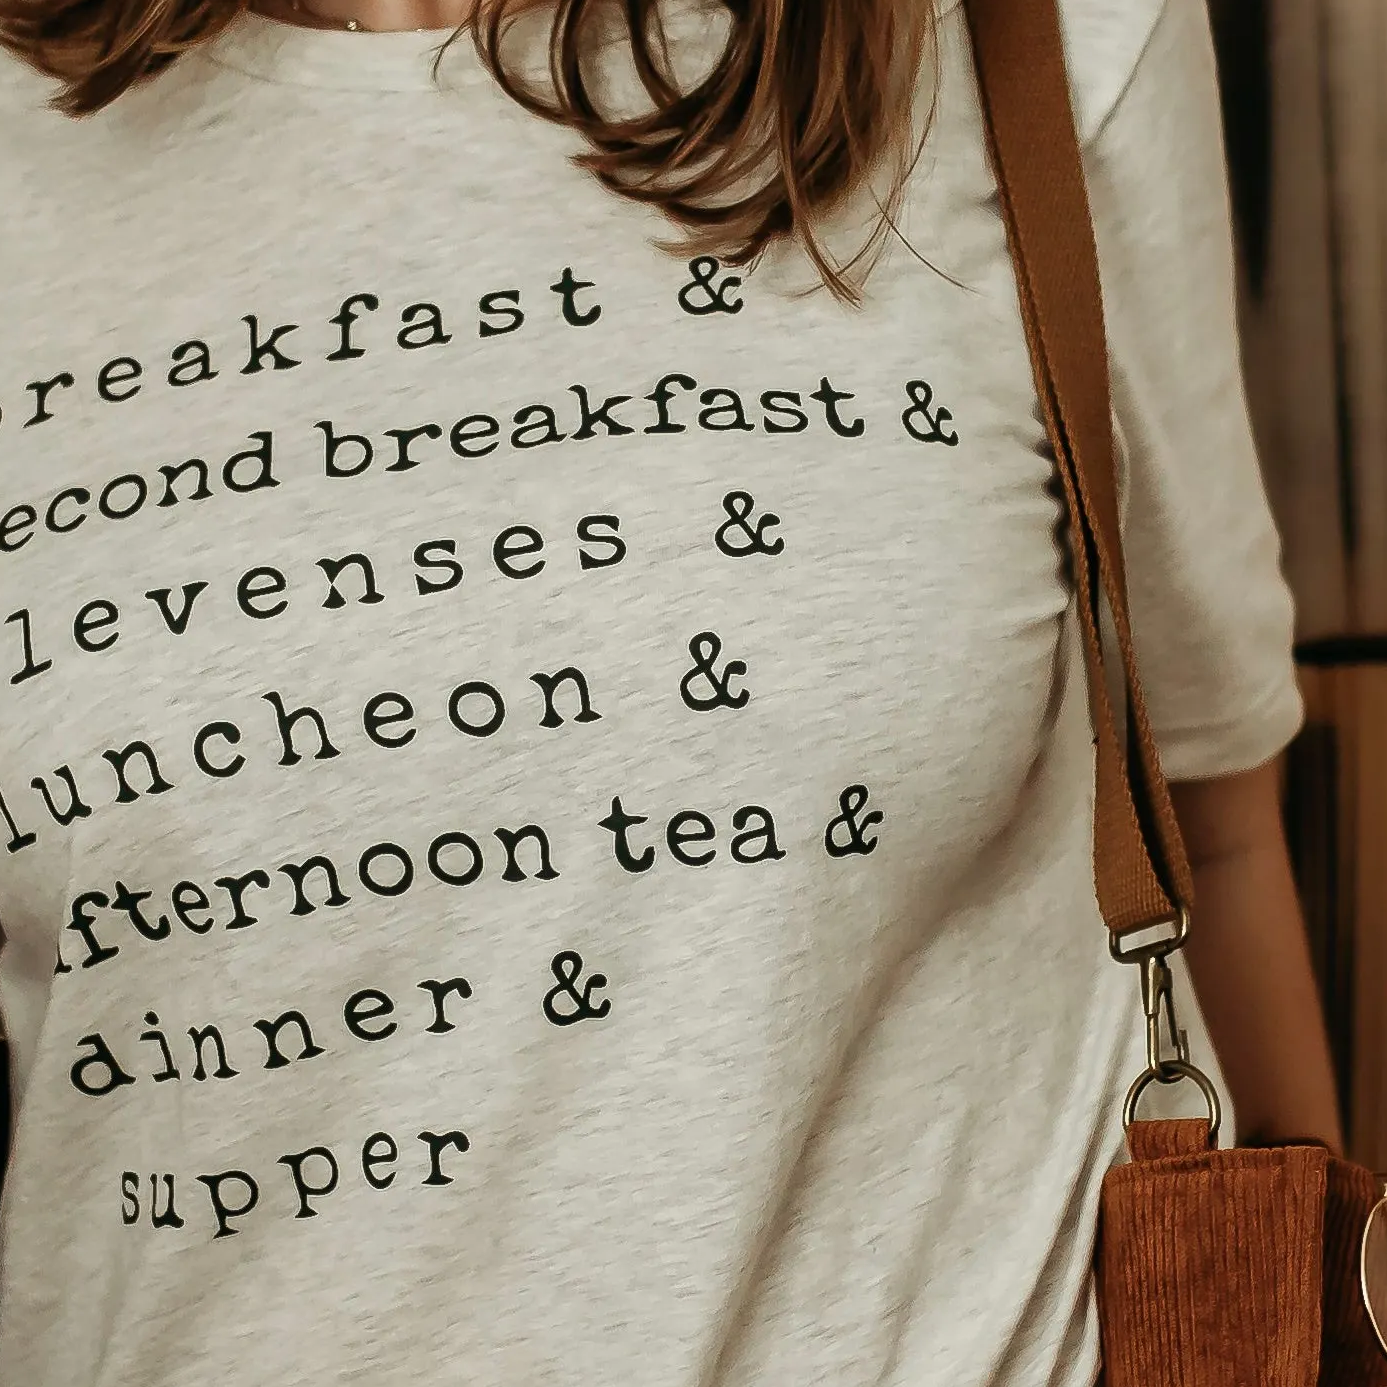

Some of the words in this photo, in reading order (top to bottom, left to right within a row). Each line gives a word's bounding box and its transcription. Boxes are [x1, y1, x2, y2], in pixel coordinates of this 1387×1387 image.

[676, 254, 745, 317] &
[312, 372, 866, 479] breakfast
[900, 379, 960, 448] &
[713, 490, 786, 559] &
[678, 630, 752, 713] &
[53, 823, 562, 976] fternoon
[595, 794, 788, 875] tea
[823, 783, 885, 859] &
[69, 976, 474, 1098] dinner
[541, 949, 613, 1028] &
[119, 1129, 472, 1241] supper
